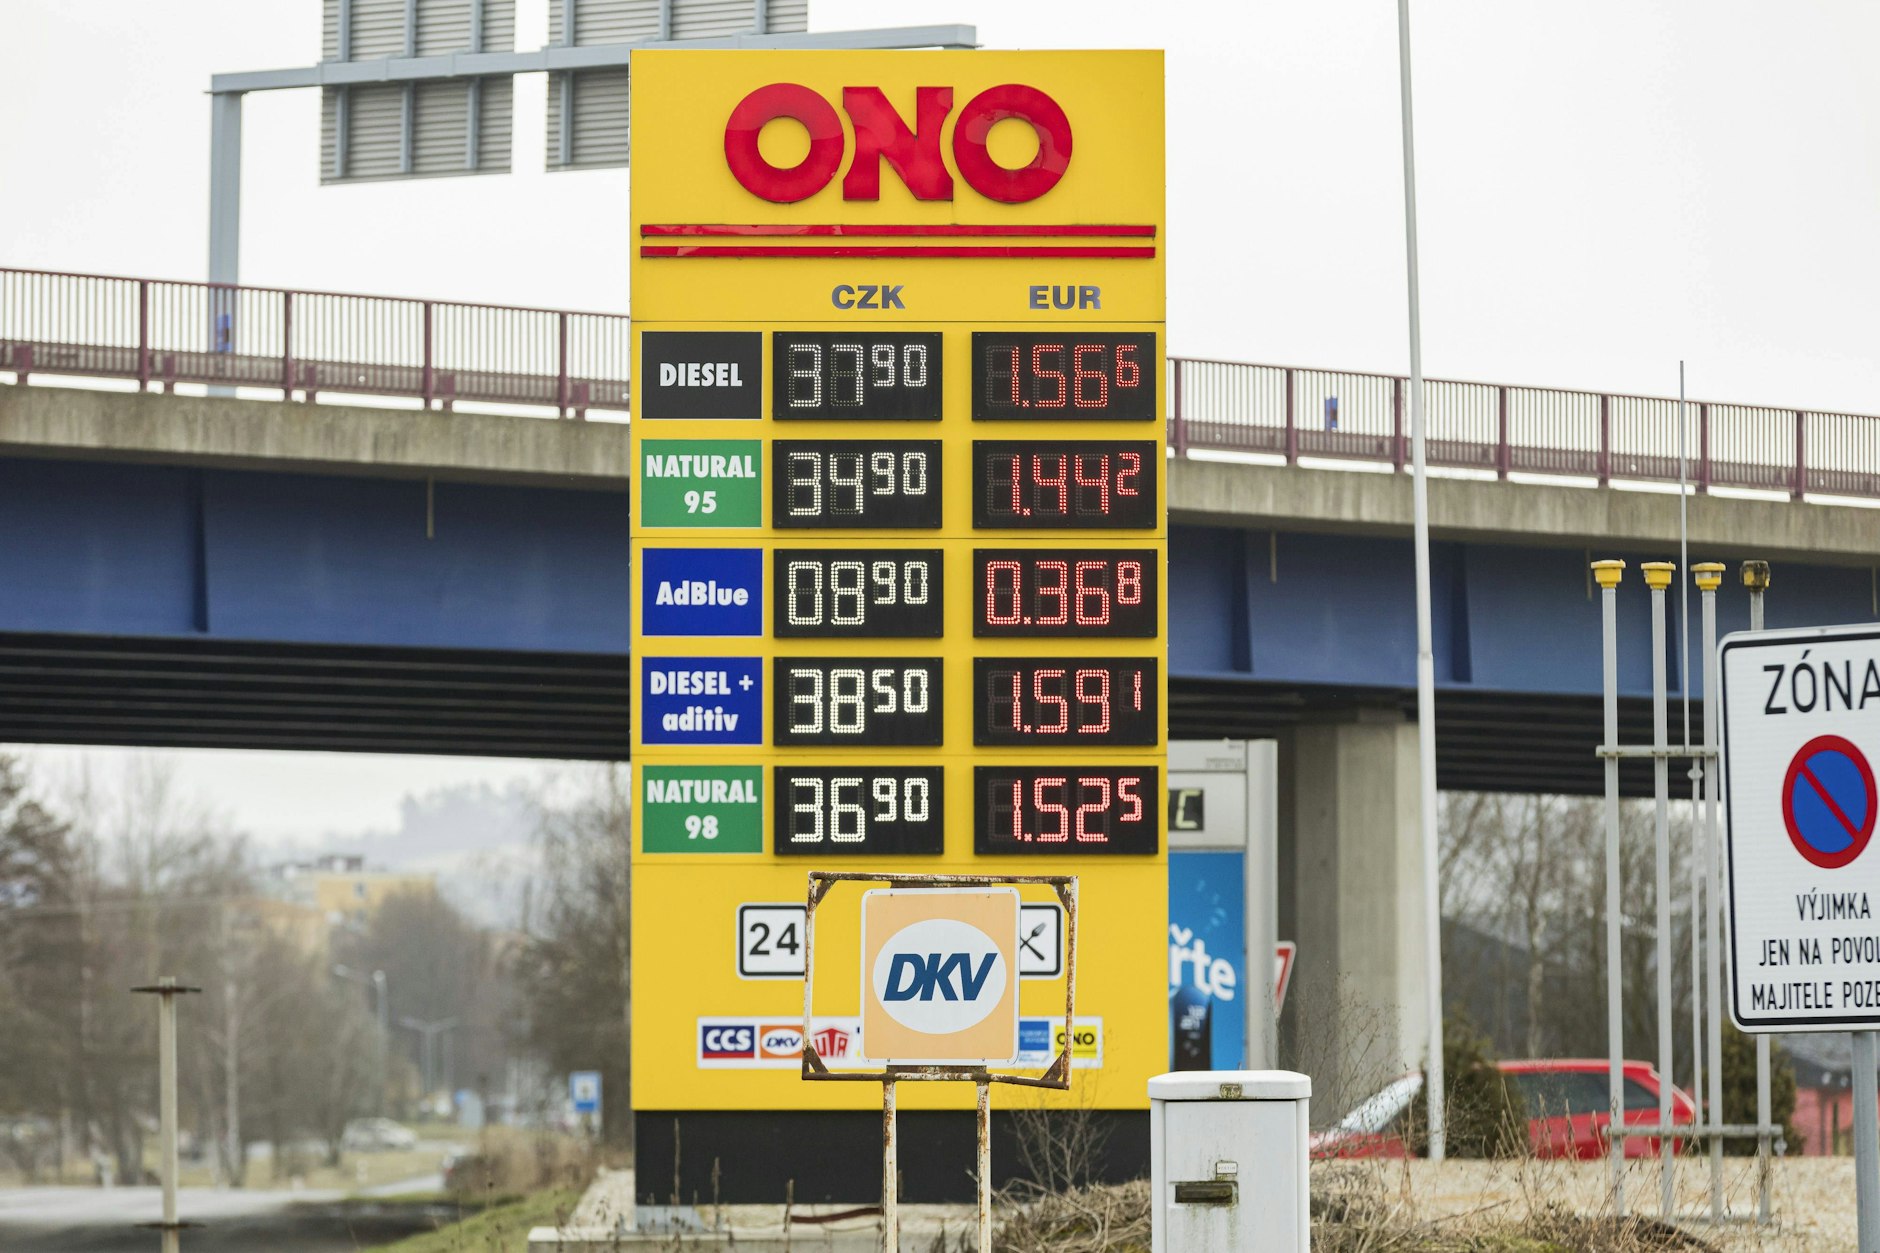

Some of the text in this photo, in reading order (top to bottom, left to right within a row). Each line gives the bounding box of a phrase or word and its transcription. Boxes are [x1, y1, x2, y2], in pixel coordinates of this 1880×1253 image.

[724, 82, 1073, 204] ONO
[831, 285, 906, 309] CZK
[1029, 285, 1101, 310] EUR
[659, 363, 742, 387] DIESEL
[646, 455, 756, 478] NATURAL
[684, 490, 717, 514] 95
[656, 580, 749, 606] AdBlue
[650, 671, 731, 696] DIESEL
[1763, 649, 1880, 715] ZÓNA
[662, 706, 739, 732] aditiv
[647, 780, 757, 803] NATURAL
[685, 815, 718, 840] 98
[1796, 886, 1871, 921] VÝJIMKA
[749, 922, 800, 956] 24
[1759, 939, 1790, 966] JEN
[1799, 938, 1822, 965] NA
[883, 952, 998, 1002] DKV
[1751, 982, 1833, 1011] MAJITELE
[705, 1028, 752, 1051] CCS
[766, 1036, 801, 1048] DKV
